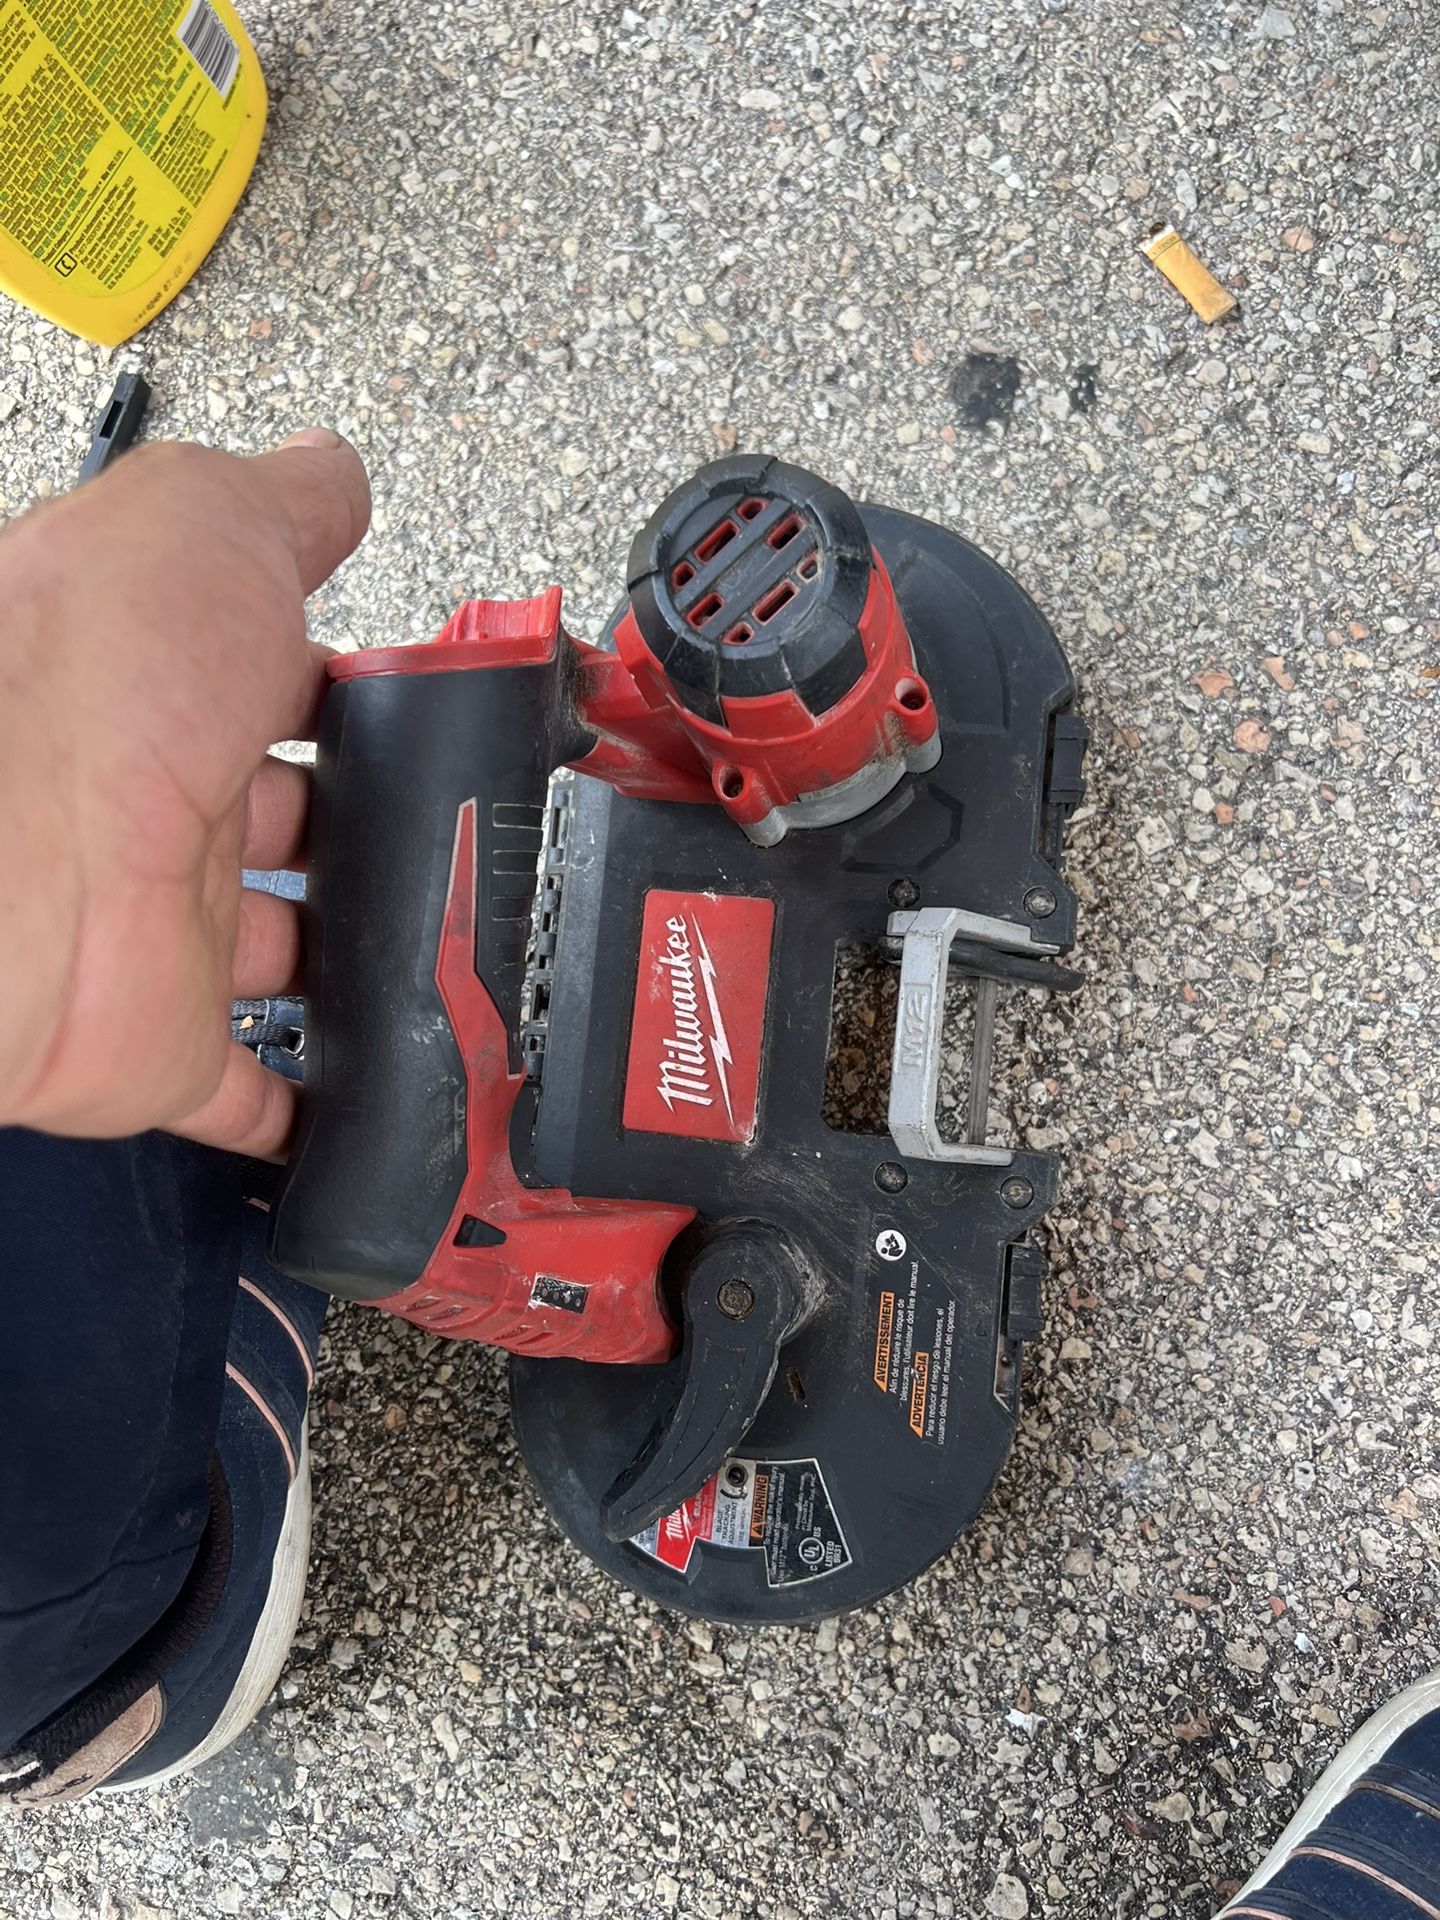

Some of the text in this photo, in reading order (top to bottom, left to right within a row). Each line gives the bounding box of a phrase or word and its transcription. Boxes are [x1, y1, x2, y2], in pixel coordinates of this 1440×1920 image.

[656, 914, 713, 1114] Milwaukee
[896, 1298, 904, 1308] de
[894, 1309, 904, 1332] risque
[875, 1293, 893, 1382] AVERTISSEMENT
[893, 1332, 901, 1340] le
[943, 1333, 952, 1345] del
[929, 1383, 937, 1391] el
[935, 1307, 944, 1315] el
[941, 1346, 951, 1373] manual
[890, 1367, 899, 1377] de
[889, 1378, 898, 1393] Afin
[910, 1354, 927, 1427] ADVERTENCIA
[938, 1397, 947, 1416] debe
[925, 1418, 935, 1436] Para
[752, 1476, 767, 1523] WARNING
[715, 1509, 723, 1532] BLADE
[721, 1504, 730, 1539] TRACKING
[728, 1501, 737, 1544] ADJUSTMENT
[813, 1526, 821, 1537] US
[825, 1540, 834, 1567] LISTED
